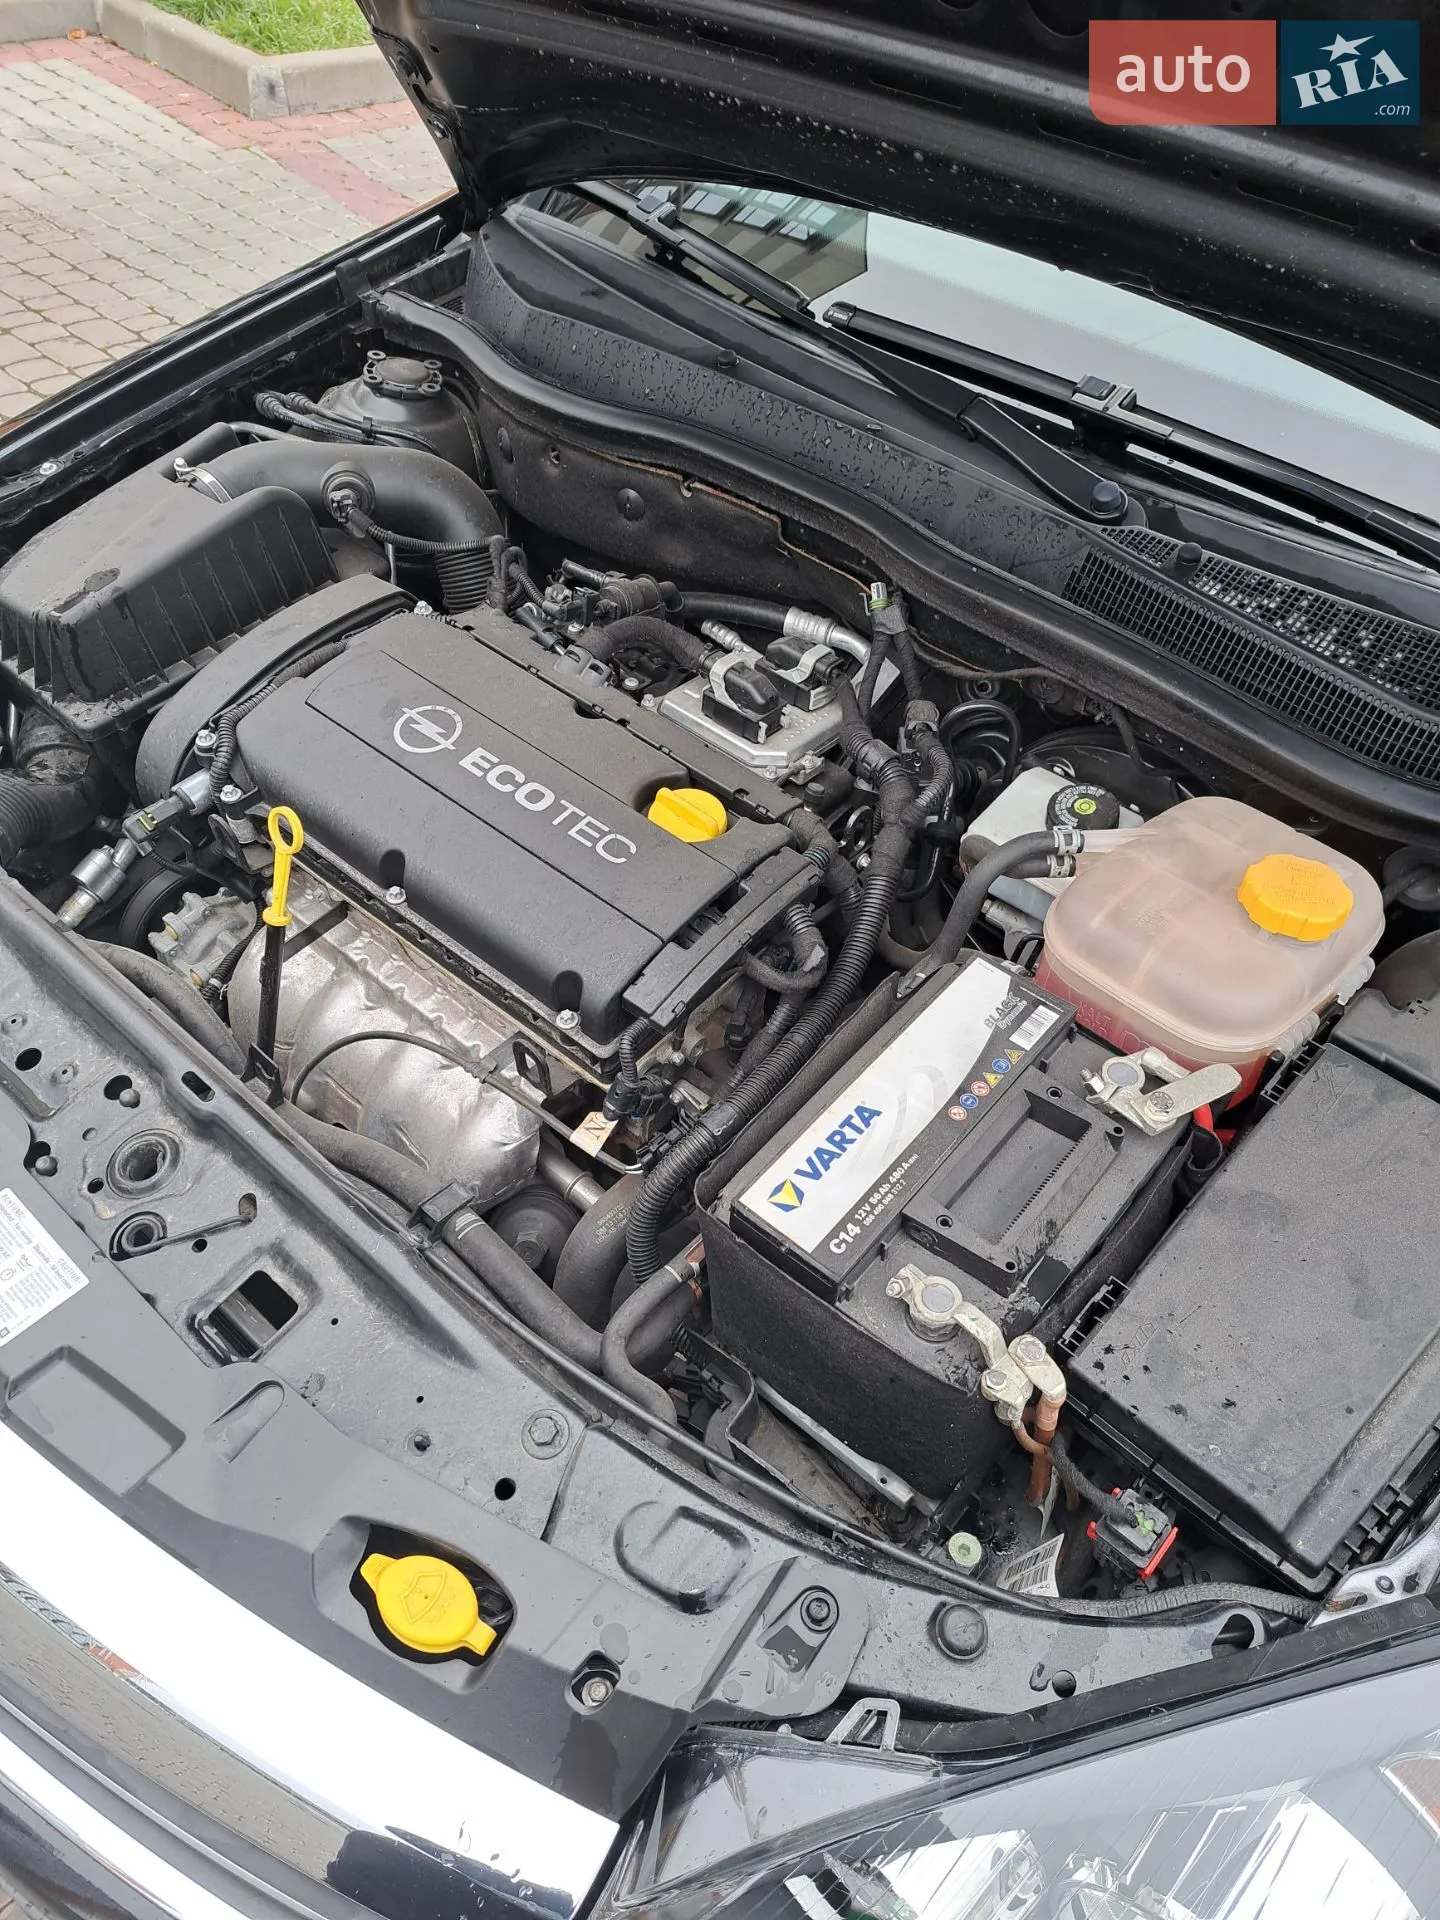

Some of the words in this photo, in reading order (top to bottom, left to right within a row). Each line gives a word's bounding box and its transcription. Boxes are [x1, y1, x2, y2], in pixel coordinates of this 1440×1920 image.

[458, 747, 637, 864] ECOTEC
[983, 991, 1021, 1030] BLACK
[997, 1000, 1028, 1030] Dynamic
[793, 1104, 883, 1181] VARTA
[854, 1202, 872, 1222] 12V
[863, 1215, 876, 1226] 556
[873, 1204, 885, 1216] 400
[883, 1193, 895, 1206] 048
[892, 1183, 903, 1196] 312
[829, 1222, 862, 1254] C14
